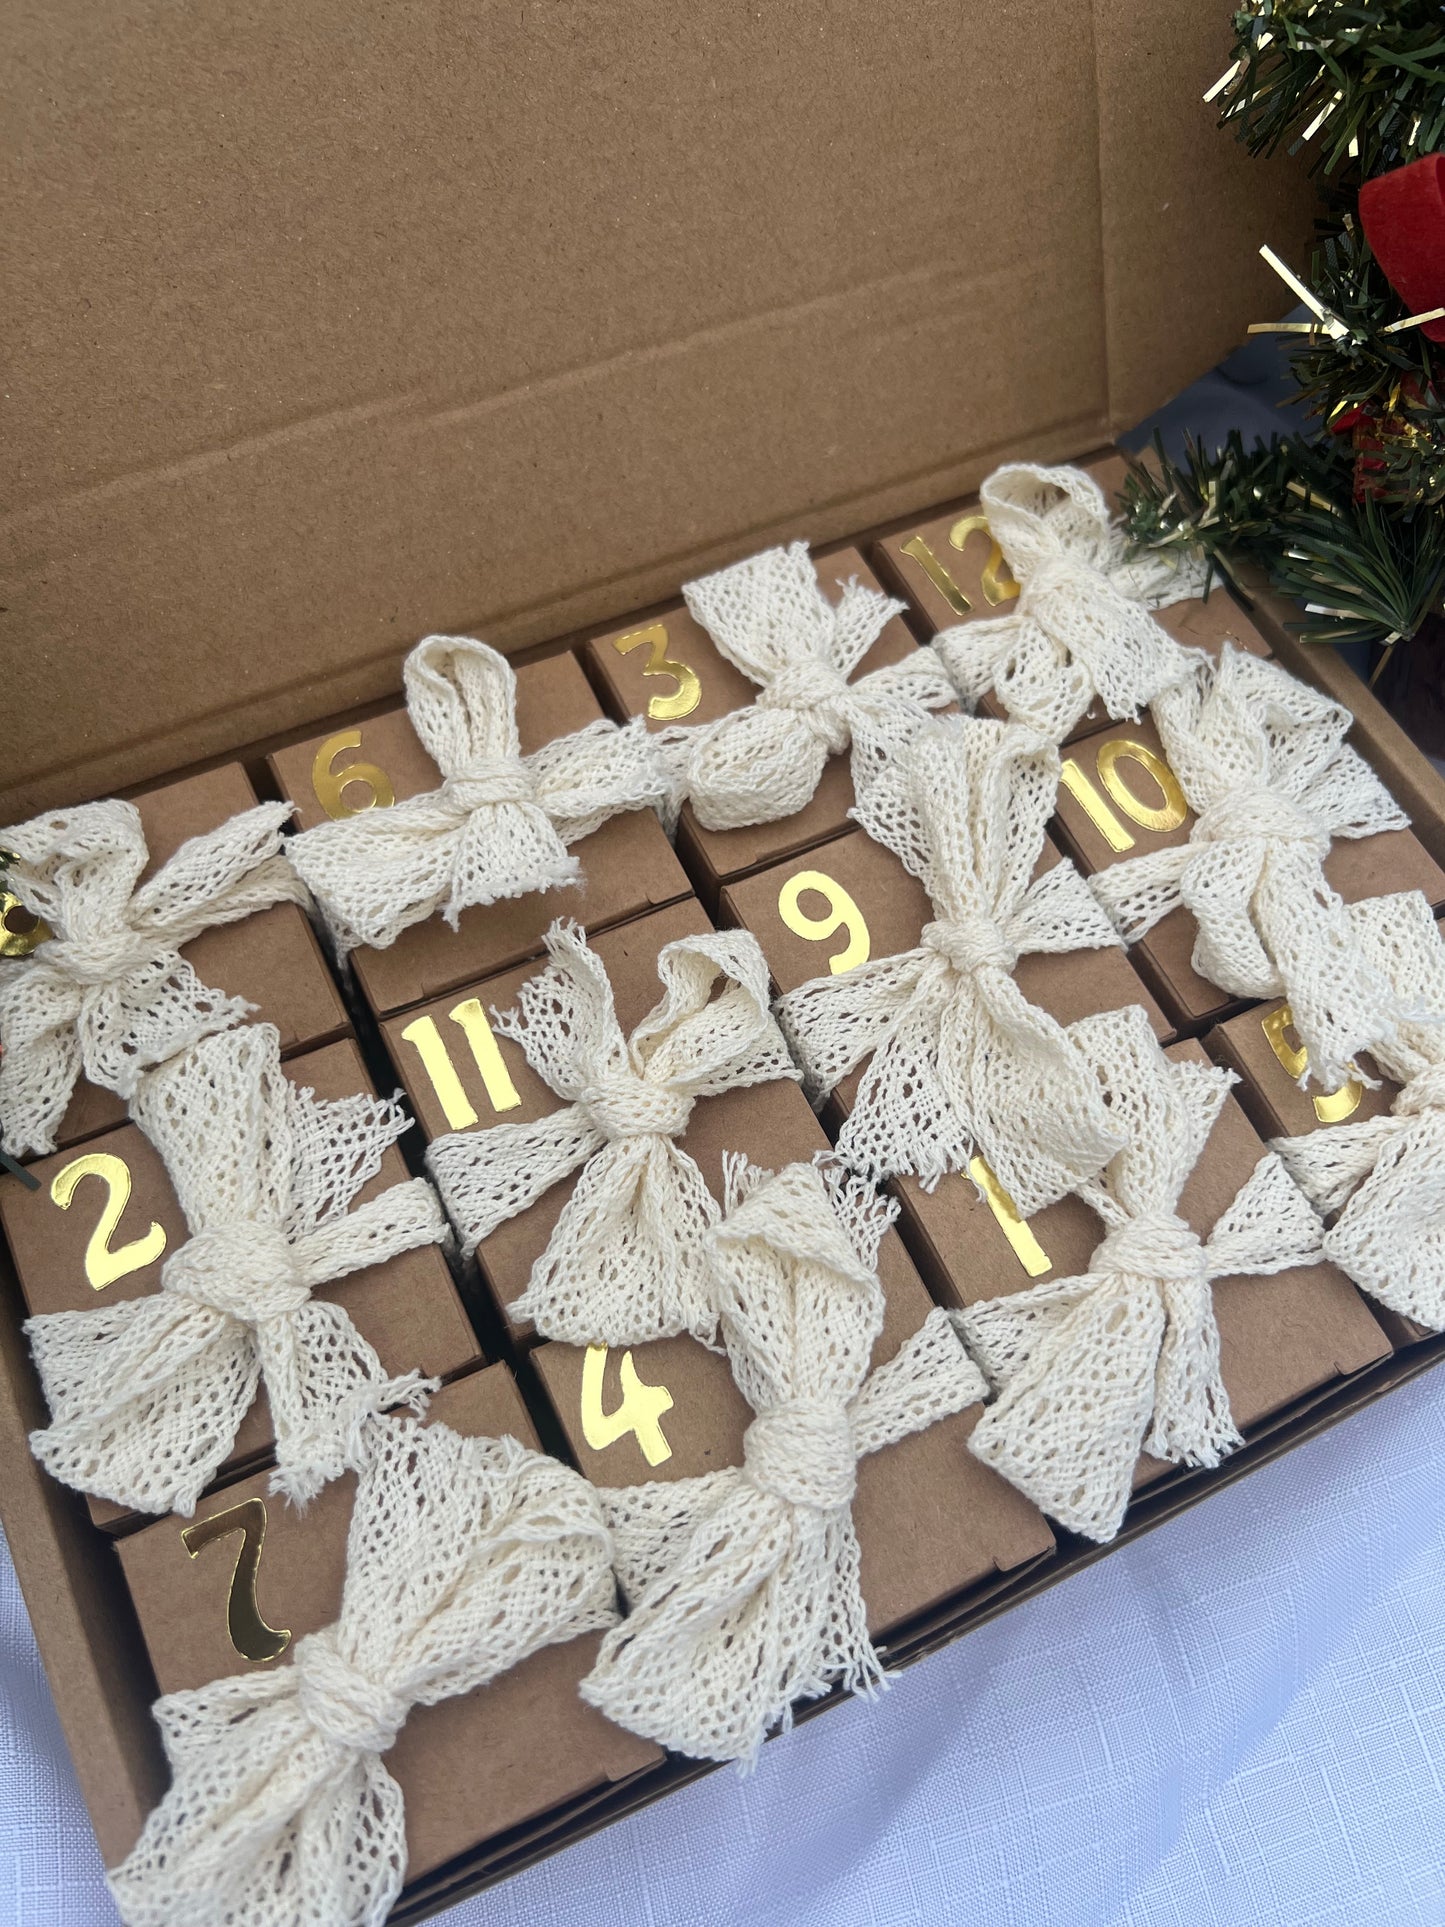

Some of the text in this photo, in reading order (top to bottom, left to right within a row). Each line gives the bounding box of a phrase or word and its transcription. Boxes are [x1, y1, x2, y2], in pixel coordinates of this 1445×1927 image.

[900, 507, 1023, 615] 12
[613, 622, 703, 721] 3
[311, 728, 397, 821] 6
[1060, 737, 1191, 855] 10
[777, 869, 871, 974] 9
[401, 997, 522, 1130] 11
[49, 1152, 168, 1291] 2
[581, 1341, 675, 1468] 4
[180, 1497, 292, 1663] 7
